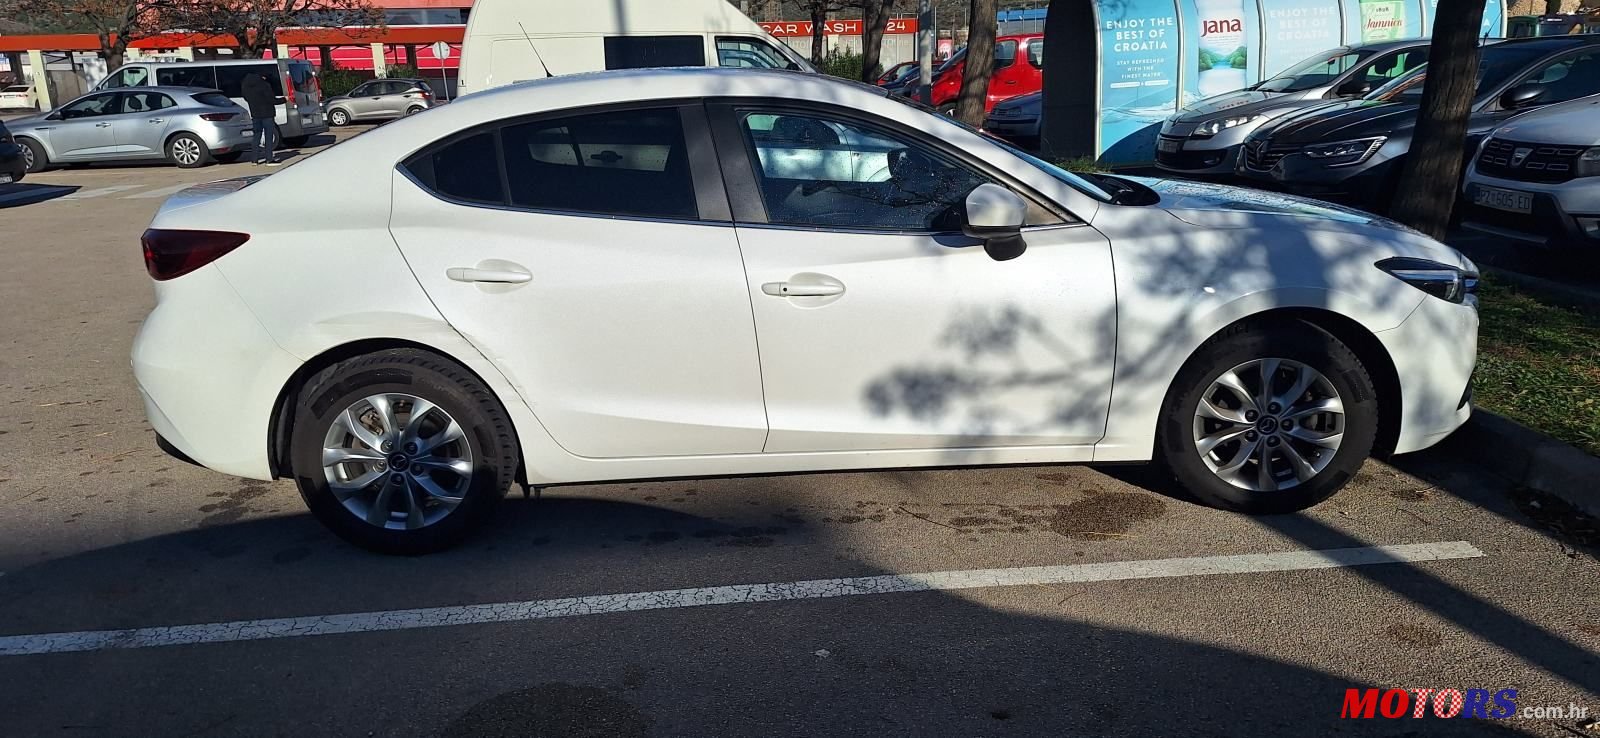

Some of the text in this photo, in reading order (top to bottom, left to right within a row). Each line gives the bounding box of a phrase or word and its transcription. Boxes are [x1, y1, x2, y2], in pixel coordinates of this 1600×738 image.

[1270, 6, 1336, 18] ENJOY THE
[762, 24, 798, 34] CAR
[887, 22, 906, 31] 24
[1106, 17, 1173, 30] ENJOY THE
[1116, 29, 1165, 41] BEST OF
[1113, 41, 1168, 52] CROATIA
